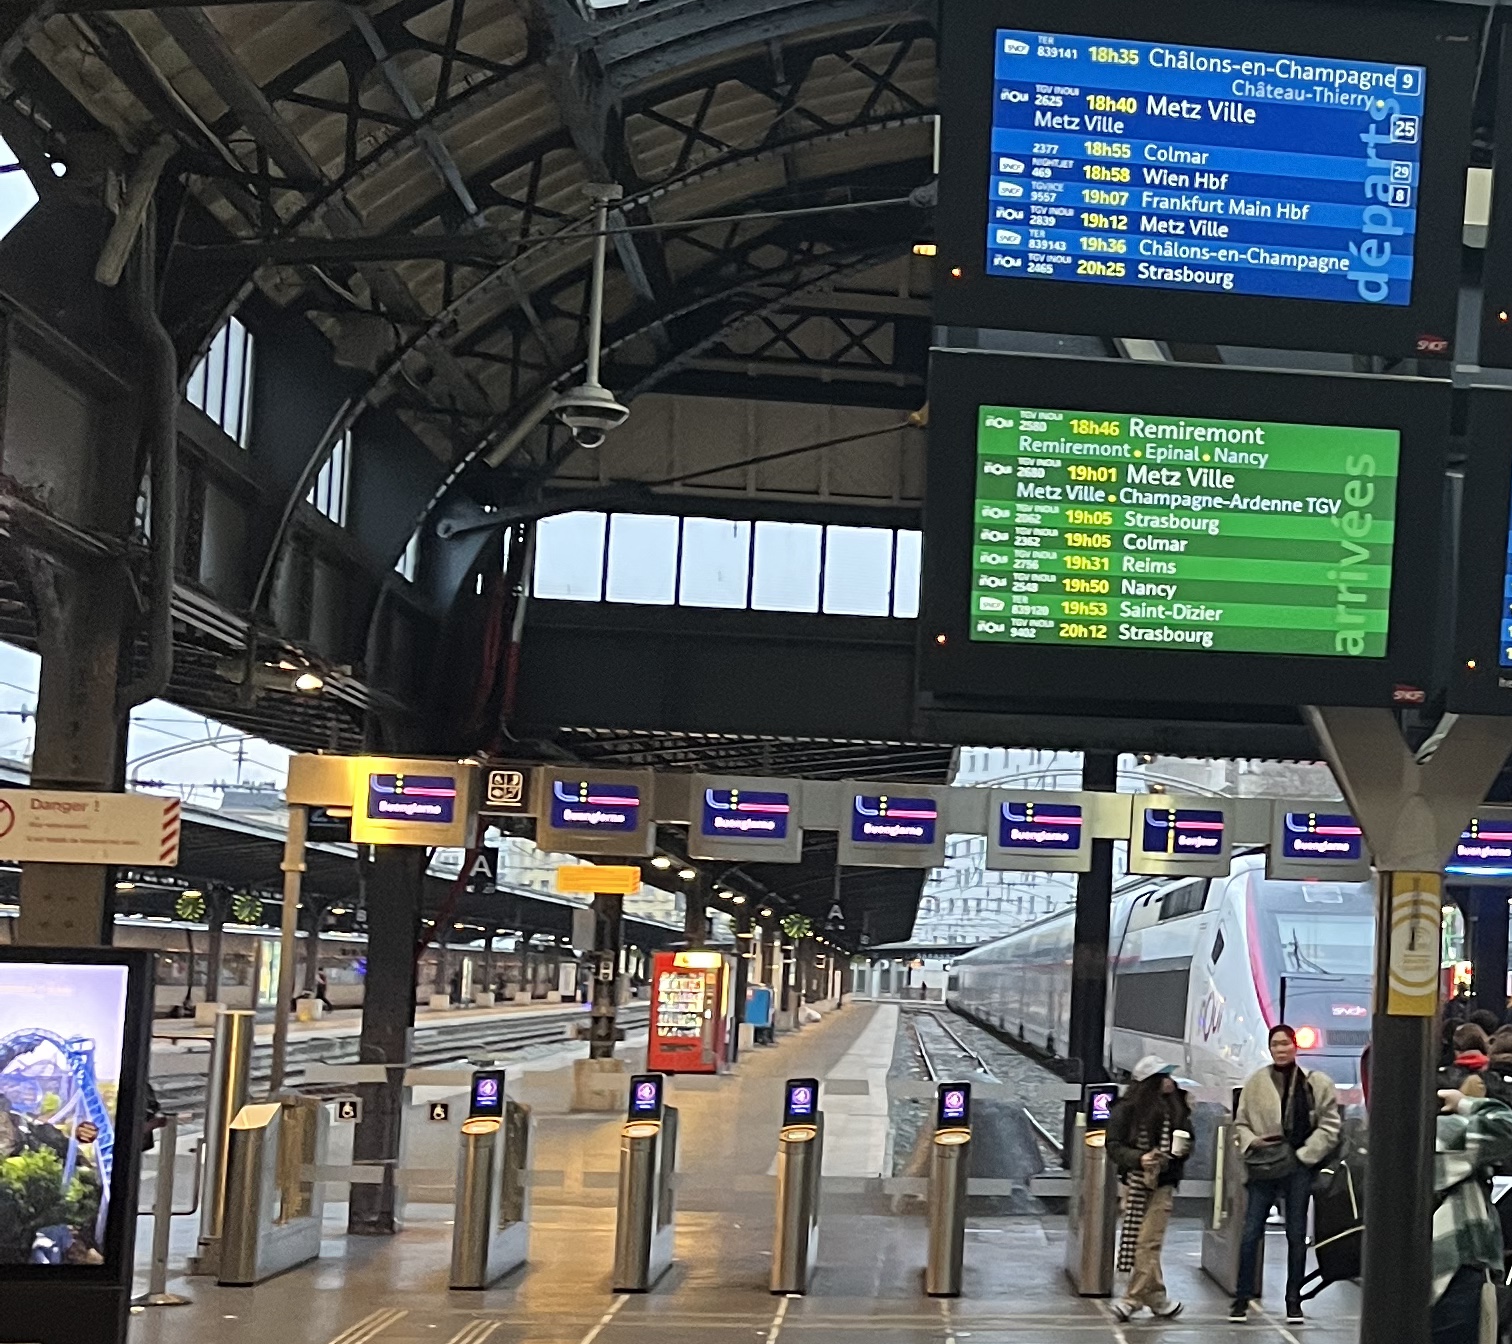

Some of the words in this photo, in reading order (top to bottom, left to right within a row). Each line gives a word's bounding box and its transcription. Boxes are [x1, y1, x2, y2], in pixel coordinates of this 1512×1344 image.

[1038, 35, 1054, 45] TER
[1037, 46, 1078, 59] 839141
[1088, 46, 1139, 65] 18h35
[1149, 47, 1395, 90] Châlons-en-Champagne
[1402, 73, 1413, 89] 9
[1231, 79, 1374, 111] Château-Thierry
[1034, 95, 1063, 107] 2625
[1086, 95, 1137, 114] 18h40
[1147, 95, 1202, 119] Metz
[1208, 99, 1256, 124] Ville
[1394, 120, 1415, 137] 25
[1034, 110, 1080, 130] Metz
[1084, 115, 1124, 134] Ville
[1032, 143, 1058, 155] 2377
[1084, 141, 1131, 158] 18h55
[1144, 144, 1209, 165] Colmar
[1394, 166, 1409, 178] 29
[1032, 167, 1051, 178] 469
[1083, 165, 1131, 182] 18h58
[1143, 167, 1189, 187] Wien
[1194, 172, 1229, 191] Hbf
[1030, 192, 1057, 203] 9557
[1081, 190, 1129, 206] 19h07
[1142, 192, 1224, 214] Frankfurt
[1229, 199, 1271, 217] Main
[1276, 202, 1310, 220] Hbf
[1347, 97, 1404, 302] départs
[1029, 230, 1046, 239] TER
[1080, 213, 1128, 230] 19h12
[1140, 215, 1185, 235] Metz
[1189, 219, 1229, 238] Ville
[1079, 237, 1127, 254] 19h36
[1139, 239, 1350, 273] Châlons-en-Champagne
[1077, 259, 1126, 277] 20h25
[1138, 262, 1235, 290] Strasbourg
[1069, 419, 1120, 436] 18h46
[1129, 417, 1265, 445] Remiremont
[1019, 435, 1131, 457] Remiremont
[1145, 443, 1200, 463] Epinal
[1213, 447, 1268, 469] Nancy
[1067, 465, 1117, 482] 19h01
[1126, 464, 1182, 486] Metz
[1186, 467, 1235, 489] Ville
[1016, 482, 1062, 500] Metz
[1065, 485, 1106, 502] Ville
[1119, 487, 1302, 513] Champagne-Ardenne
[1306, 498, 1342, 514] TGV
[1065, 510, 1113, 526] 19h05
[1124, 510, 1220, 535] Strasbourg
[1064, 533, 1112, 549] 19h05
[1123, 534, 1188, 552] Colmar
[1327, 454, 1376, 655] arrivées
[1063, 555, 1110, 571] 19h31
[1122, 556, 1177, 574] Reims
[1062, 578, 1110, 594] 19h50
[1121, 579, 1177, 600] Nancy
[1061, 601, 1108, 617] 19h53
[1120, 601, 1223, 621] Saint-Dizier
[1059, 623, 1107, 639] 20h12
[1119, 624, 1214, 648] Strasbourg
[31, 798, 89, 814] Danger
[469, 855, 493, 877] A
[828, 905, 844, 919] A
